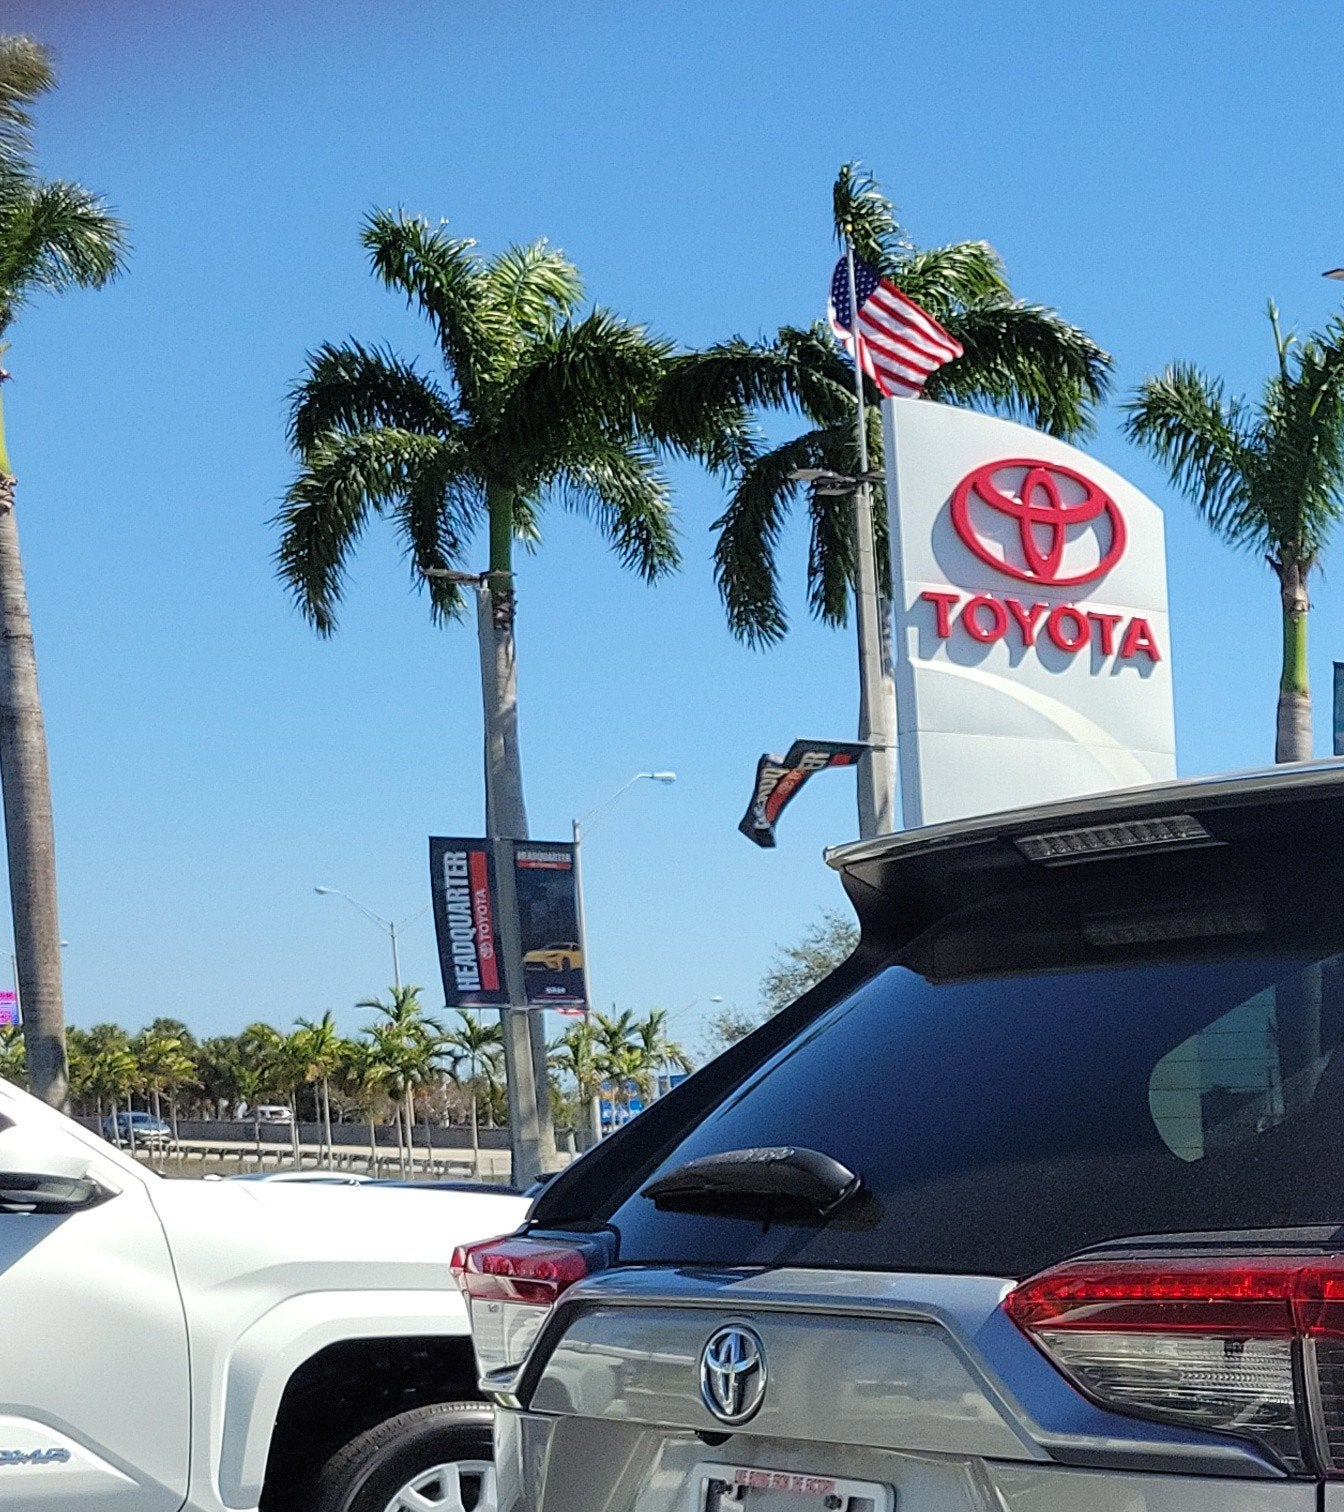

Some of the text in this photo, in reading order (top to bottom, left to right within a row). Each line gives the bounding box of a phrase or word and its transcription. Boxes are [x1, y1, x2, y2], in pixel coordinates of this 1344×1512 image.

[921, 591, 1161, 662] TOYOTA
[443, 850, 482, 992] HEADQUARTER
[474, 888, 492, 944] TOYOTA
